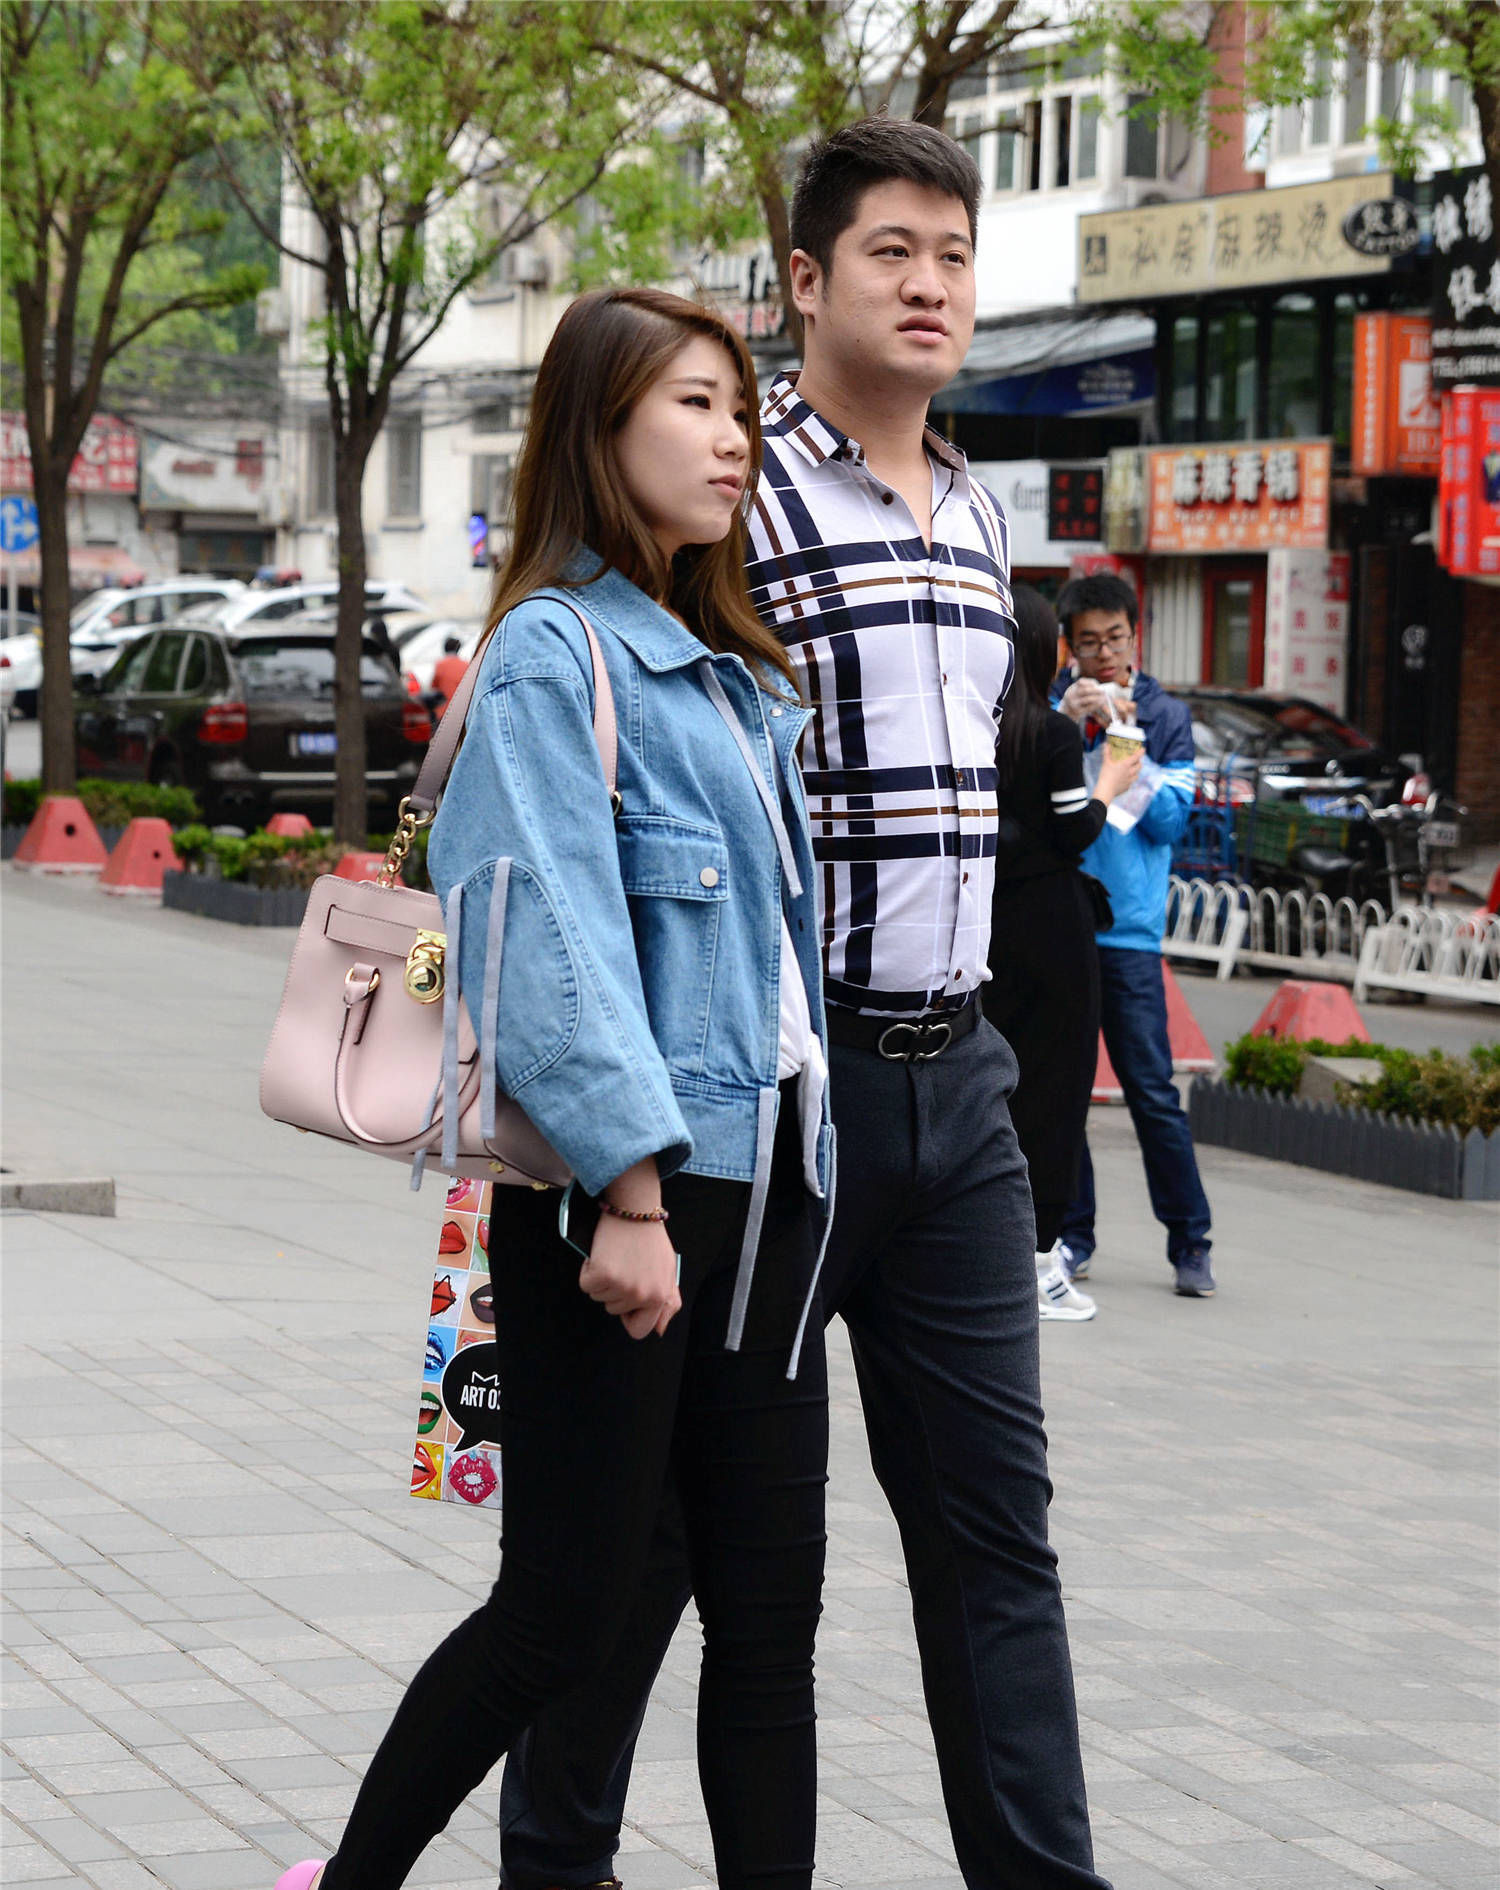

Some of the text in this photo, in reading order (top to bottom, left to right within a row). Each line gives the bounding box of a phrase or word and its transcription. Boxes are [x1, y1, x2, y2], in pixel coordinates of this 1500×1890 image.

[1173, 449, 1298, 504] 麻辣香锅
[460, 1384, 486, 1408] ART
